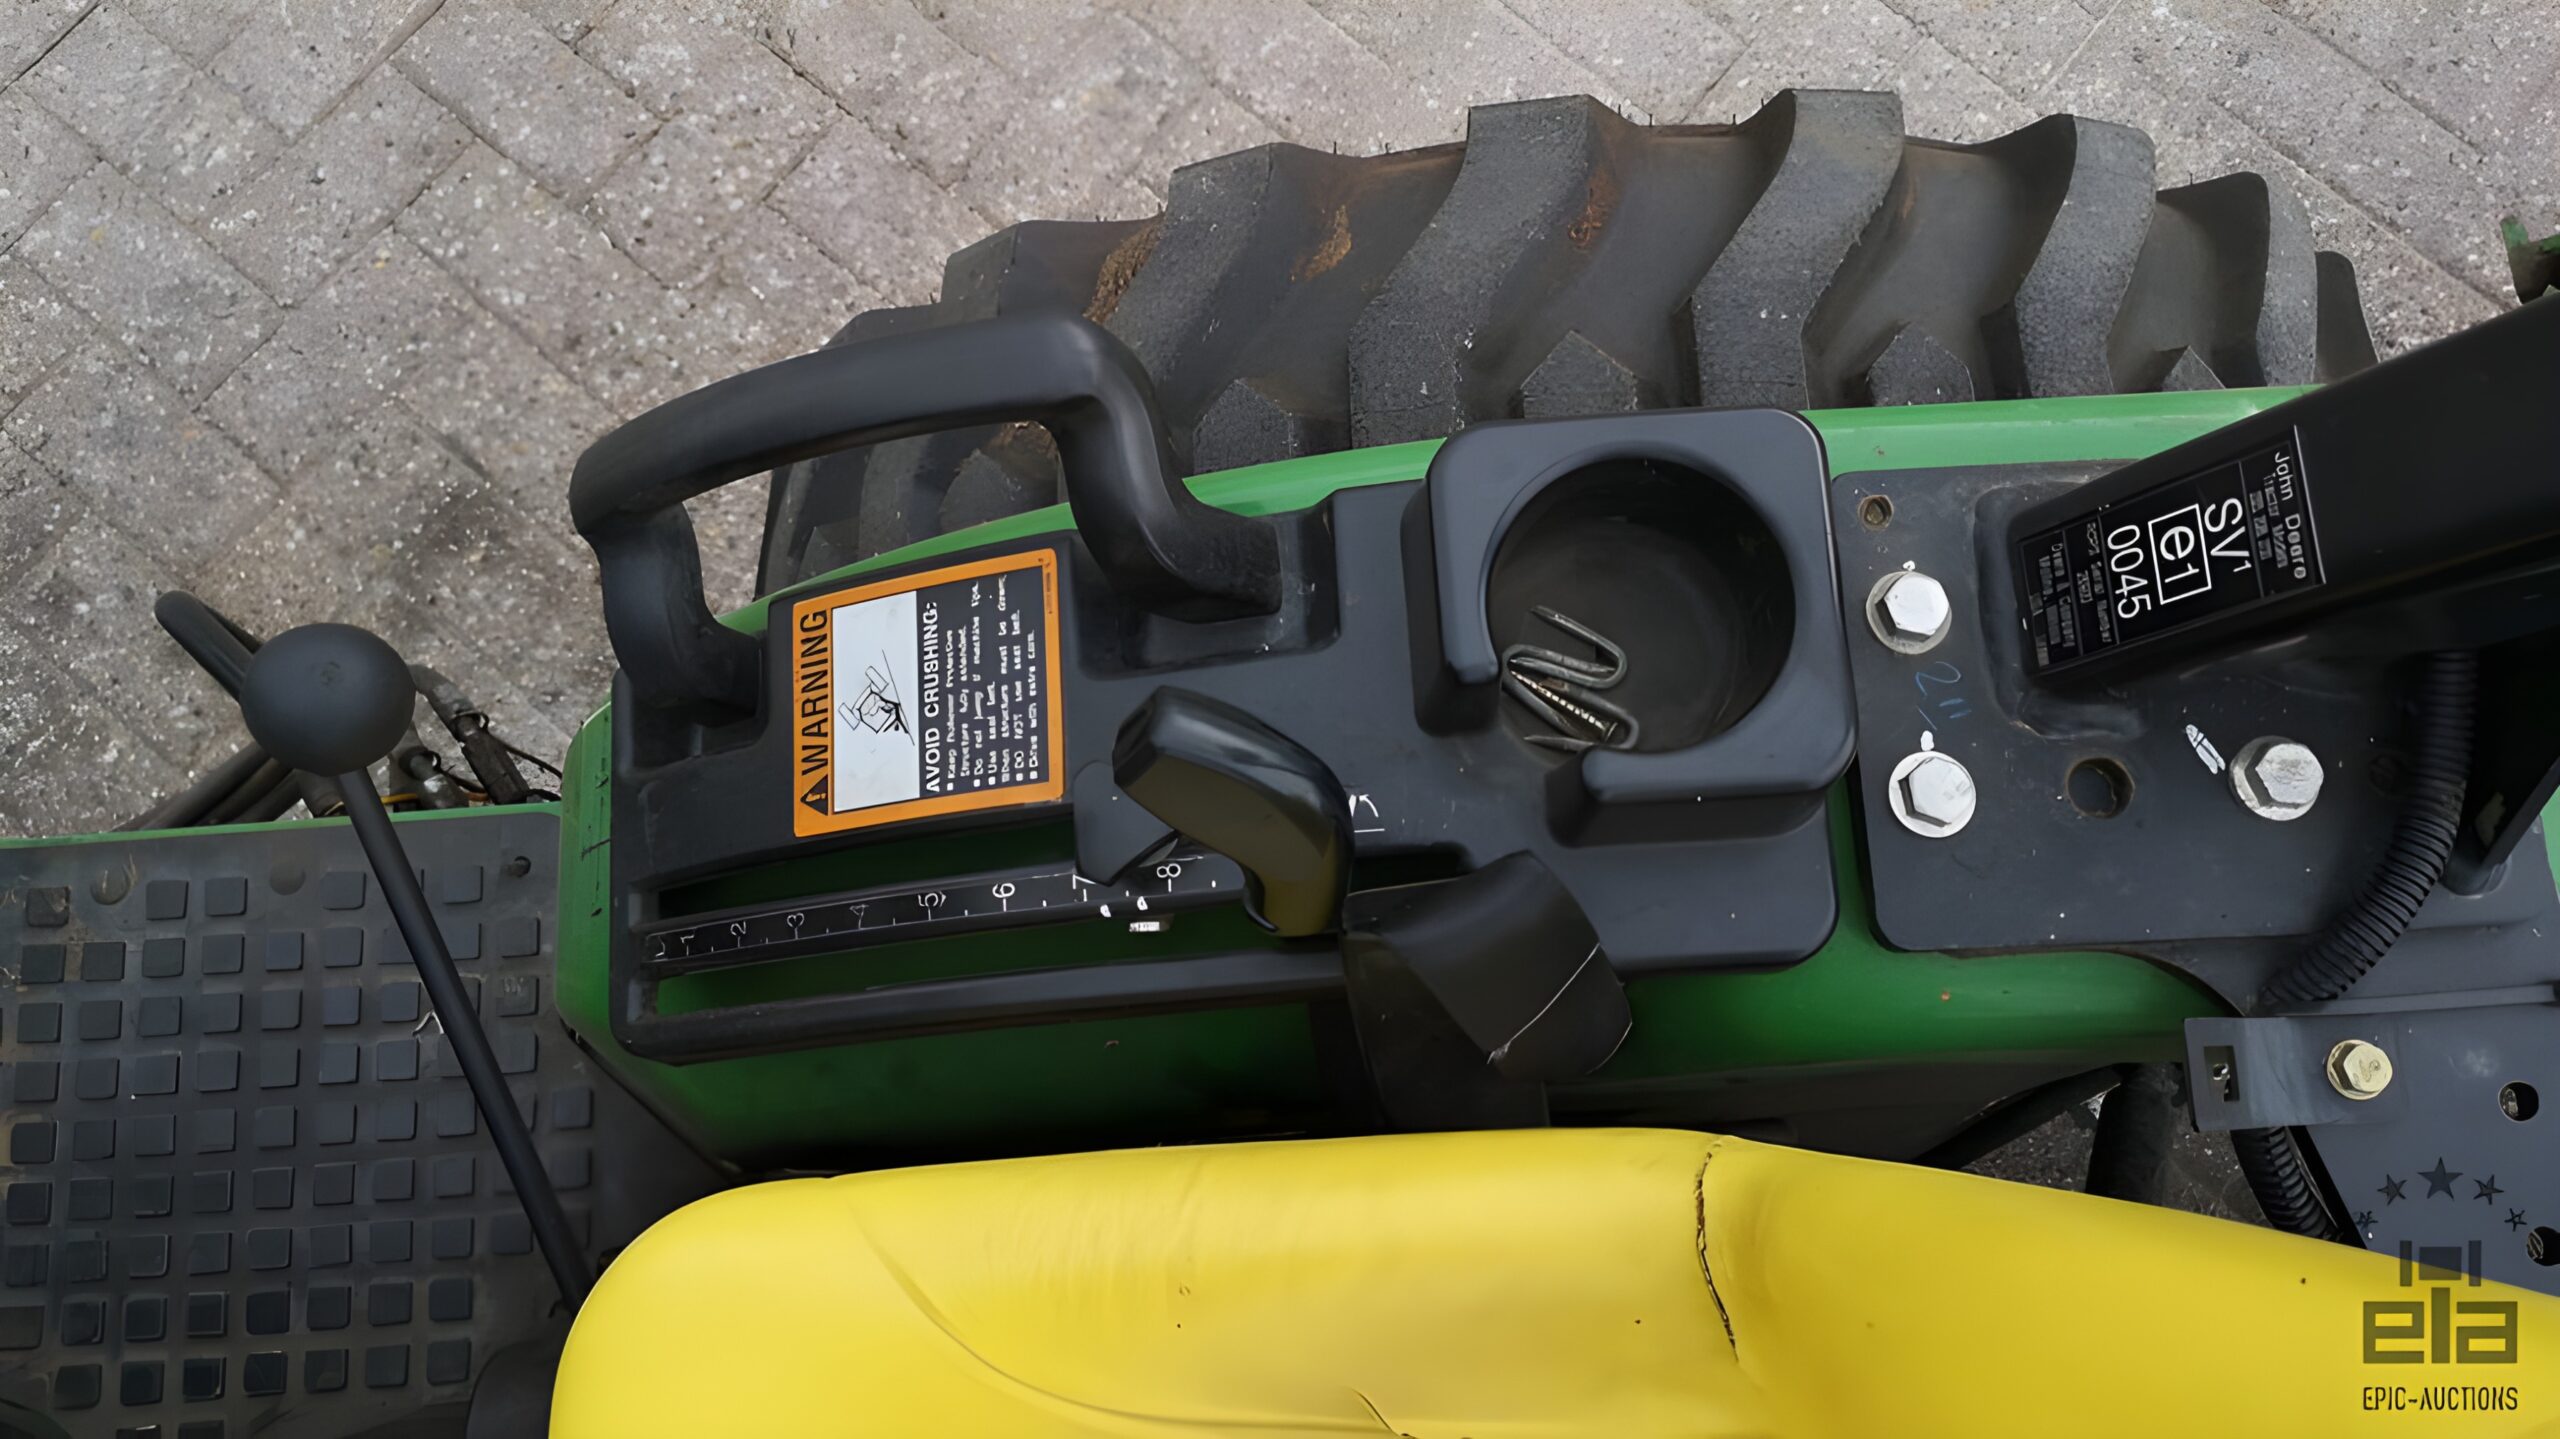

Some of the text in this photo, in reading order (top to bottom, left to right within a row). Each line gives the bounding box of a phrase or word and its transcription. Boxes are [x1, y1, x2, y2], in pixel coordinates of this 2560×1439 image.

[2275, 452, 2294, 501] John
[2107, 524, 2152, 619] 0045
[2160, 526, 2200, 583] e1
[799, 609, 829, 776] WARNING
[925, 727, 941, 792] AVOID
[730, 920, 747, 936] 2
[786, 912, 804, 928] 3
[992, 882, 1015, 898] 6
[1156, 863, 1182, 878] 8
